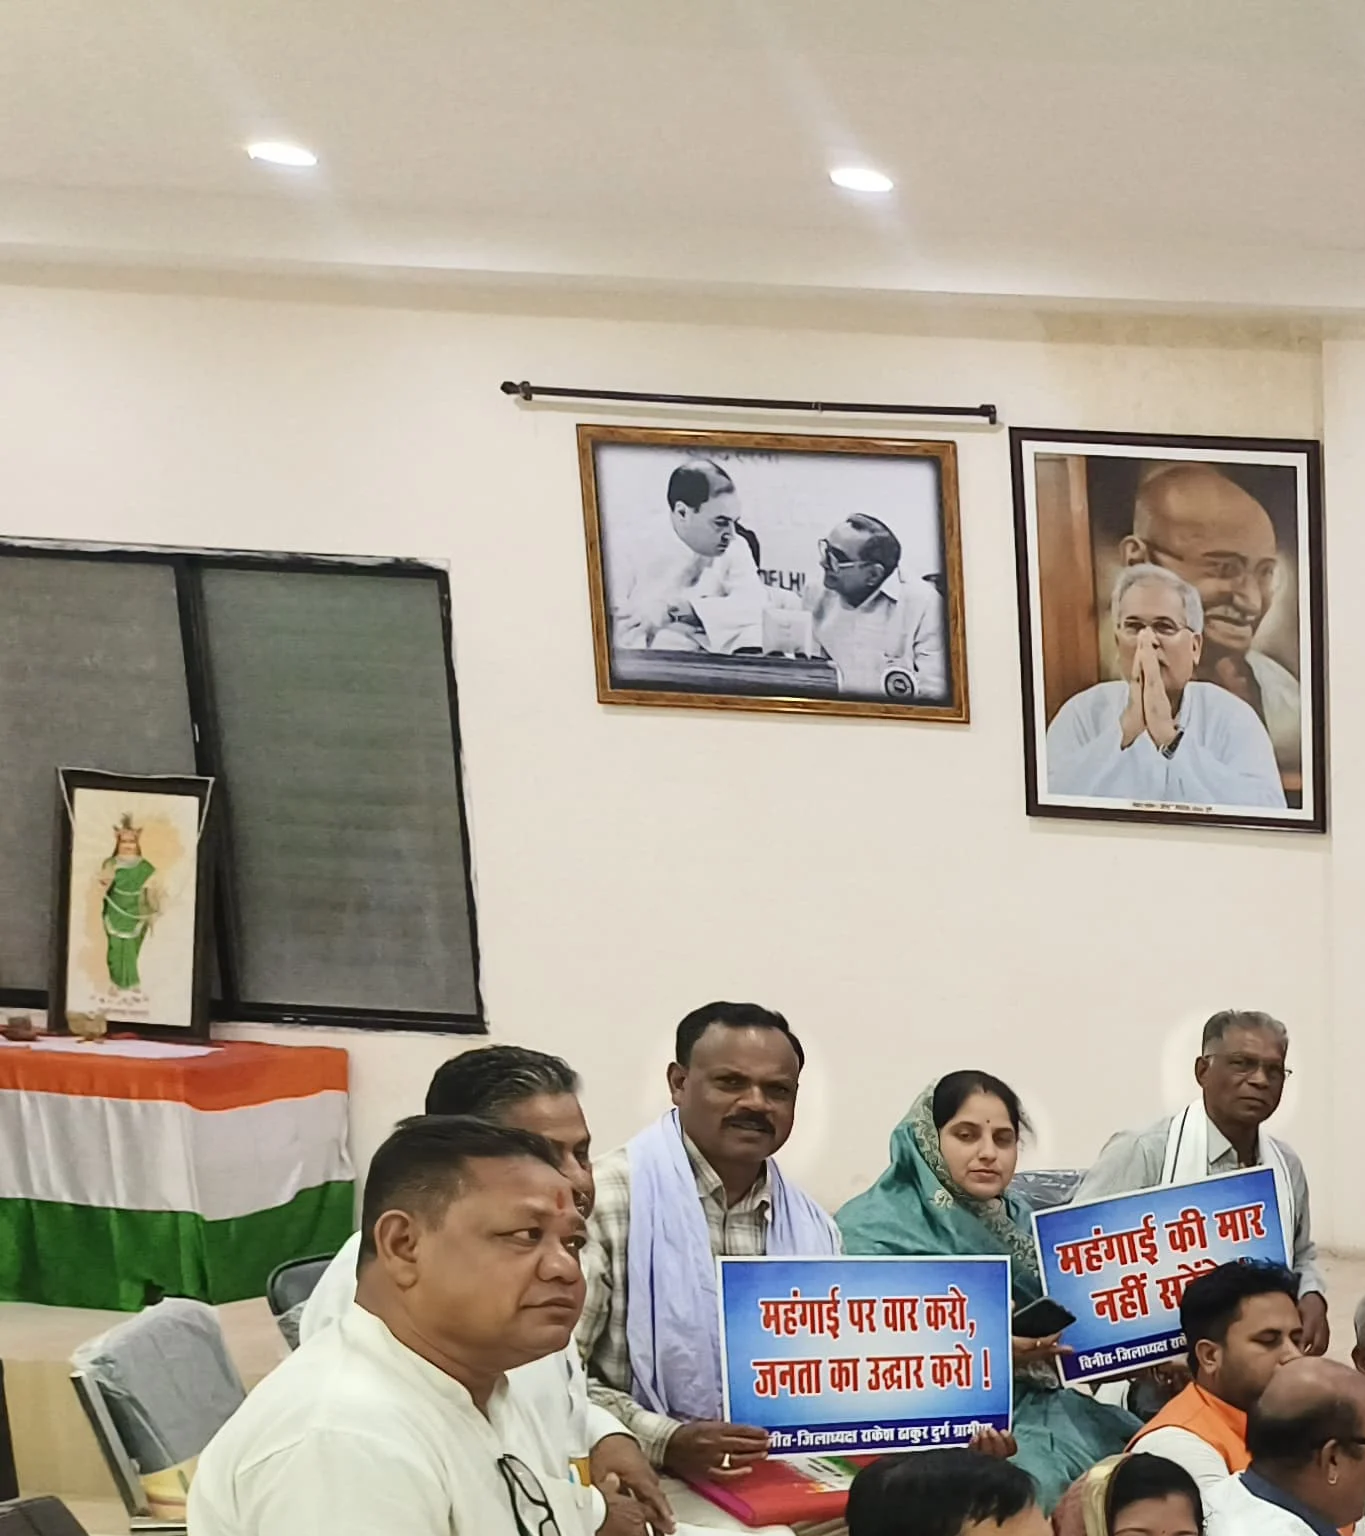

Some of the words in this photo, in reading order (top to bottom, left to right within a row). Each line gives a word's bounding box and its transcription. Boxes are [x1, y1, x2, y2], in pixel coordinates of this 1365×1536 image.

[1056, 1215, 1159, 1275] महंगाई
[1165, 1208, 1207, 1253] की
[1215, 1203, 1265, 1242] मार
[760, 1288, 840, 1339] महंगाई
[847, 1299, 877, 1333] पर
[883, 1298, 918, 1332] वार
[924, 1287, 976, 1338] करो,
[1091, 1272, 1149, 1323] नहीं
[752, 1360, 822, 1396] जनता
[829, 1358, 860, 1392] का
[930, 1344, 972, 1388] करो
[768, 1430, 857, 1448] नीत-जिलाध्यक्ष
[861, 1425, 894, 1442] राकेश
[898, 1427, 927, 1443] ठाकुर
[931, 1421, 950, 1443] दुर्ग
